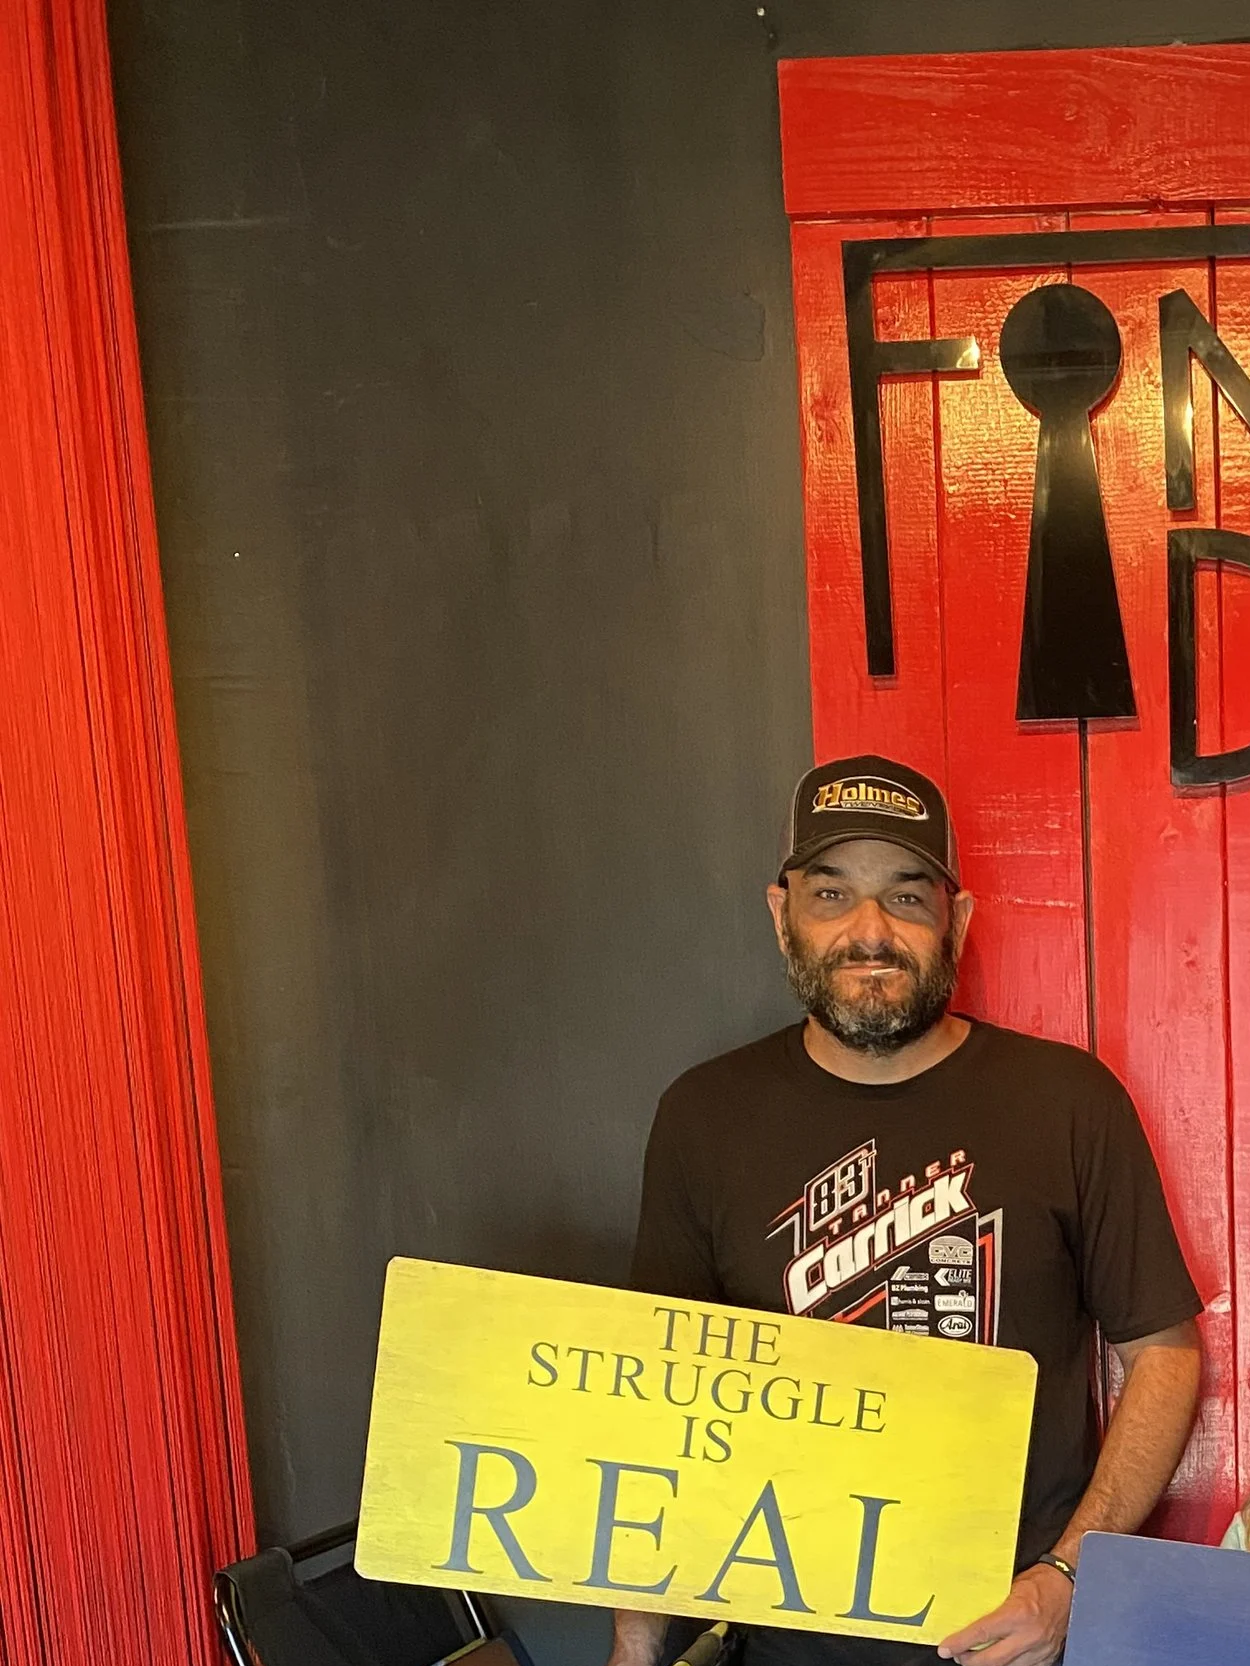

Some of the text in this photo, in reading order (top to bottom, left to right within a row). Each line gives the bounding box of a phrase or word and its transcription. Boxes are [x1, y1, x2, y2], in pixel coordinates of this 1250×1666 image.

[818, 782, 920, 813] Holmes
[828, 1149, 967, 1236] TANNER
[949, 1268, 972, 1279] ELITE
[937, 1299, 973, 1308] EMERALD
[653, 1306, 782, 1367] THE
[526, 1342, 888, 1433] STRUGGLE
[676, 1415, 733, 1463] IS
[431, 1439, 936, 1628] REAL
